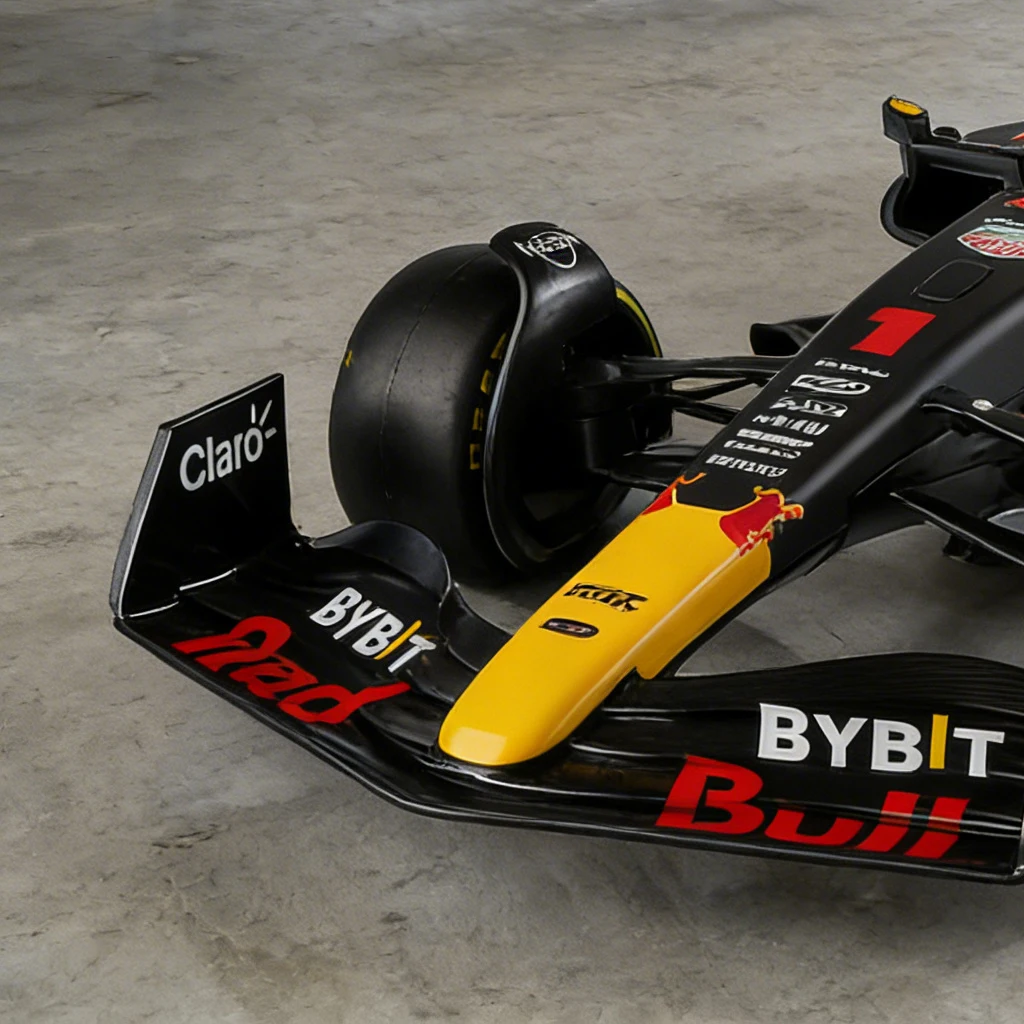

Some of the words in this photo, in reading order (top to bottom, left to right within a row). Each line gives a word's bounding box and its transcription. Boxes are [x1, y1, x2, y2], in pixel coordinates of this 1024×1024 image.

[850, 307, 937, 357] 1
[179, 416, 267, 491] Claro
[308, 586, 437, 674] BYBIT
[757, 701, 1006, 778] BYBIT
[655, 754, 970, 858] Bull
